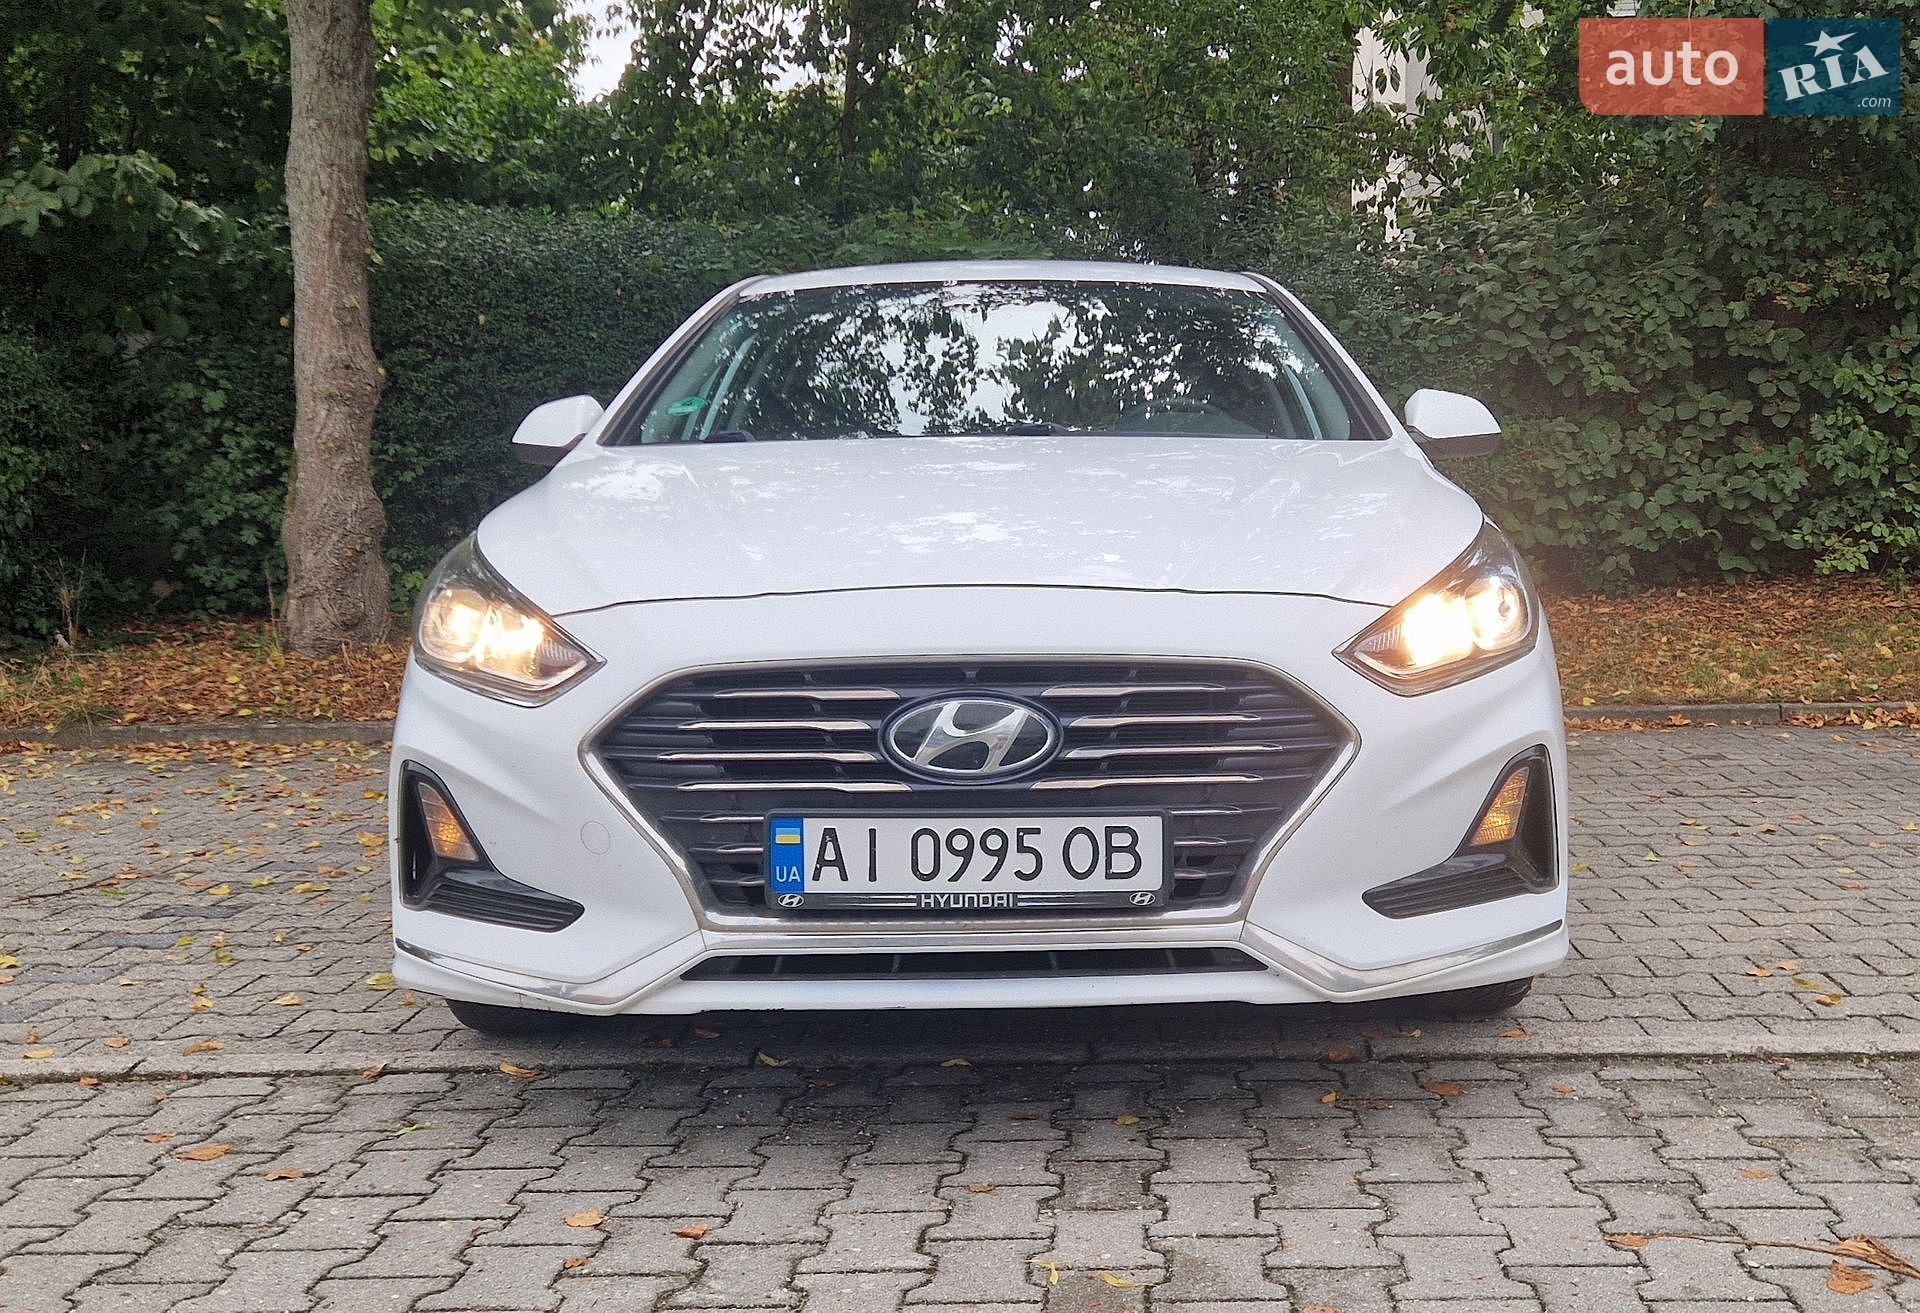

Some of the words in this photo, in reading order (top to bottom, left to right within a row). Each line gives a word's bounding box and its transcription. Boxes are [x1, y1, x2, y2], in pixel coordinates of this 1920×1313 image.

[910, 826, 1044, 883] 0995
[1061, 825, 1142, 881] OB
[775, 866, 801, 883] UA
[920, 893, 1014, 908] HYUNDAI
